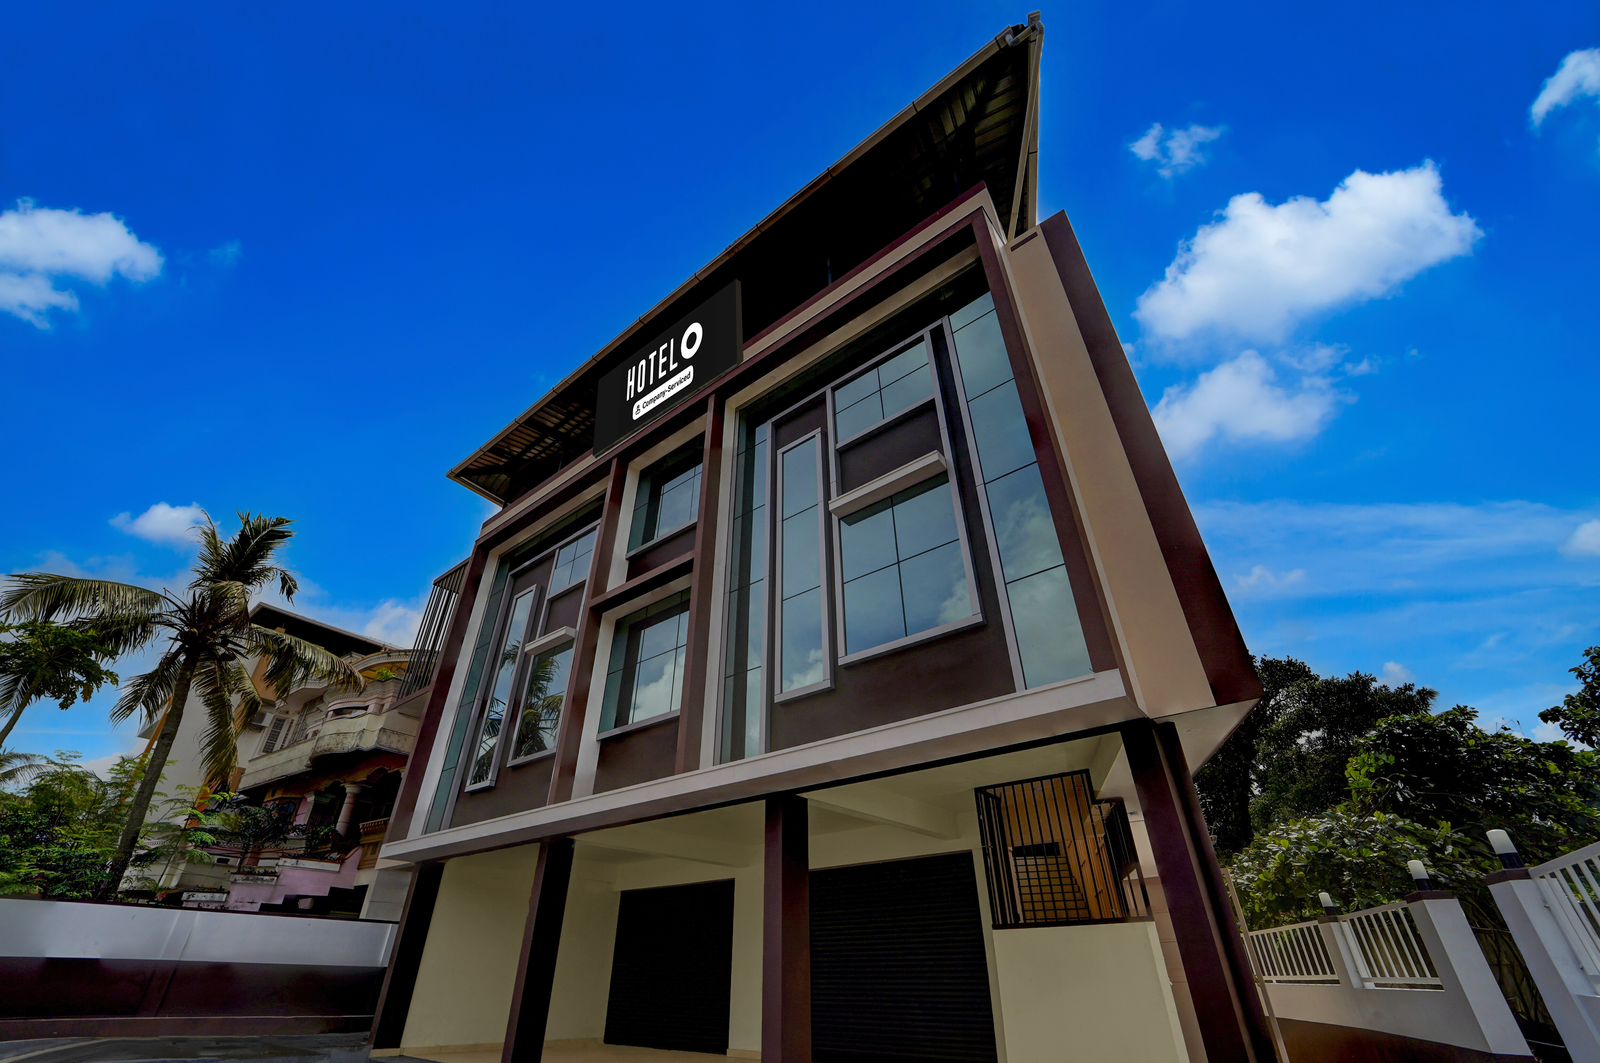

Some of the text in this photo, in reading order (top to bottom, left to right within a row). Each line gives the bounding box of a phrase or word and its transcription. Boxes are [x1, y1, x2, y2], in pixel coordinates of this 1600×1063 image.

[626, 322, 703, 401] HOTEL O
[642, 371, 691, 409] Company-Serviced
